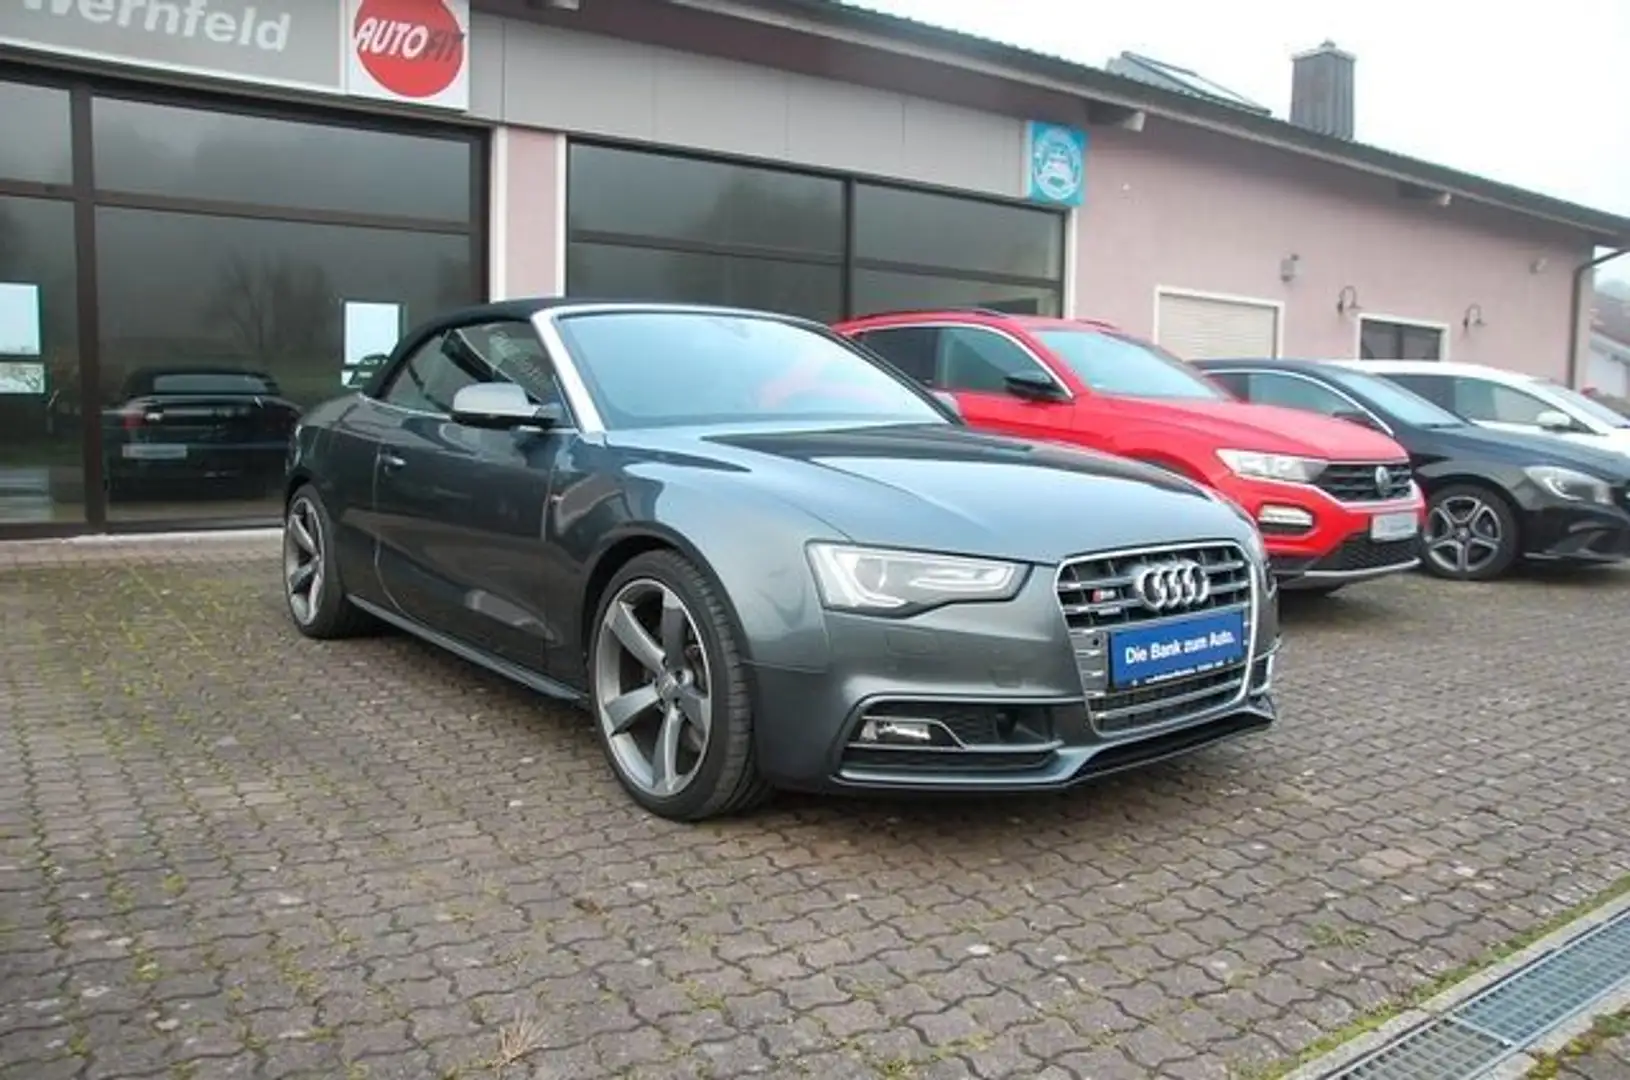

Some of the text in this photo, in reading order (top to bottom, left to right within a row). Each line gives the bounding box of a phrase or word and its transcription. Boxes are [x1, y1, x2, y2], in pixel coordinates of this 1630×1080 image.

[1125, 646, 1147, 665] Die
[1151, 640, 1182, 660] Bank
[1184, 637, 1208, 653] zum
